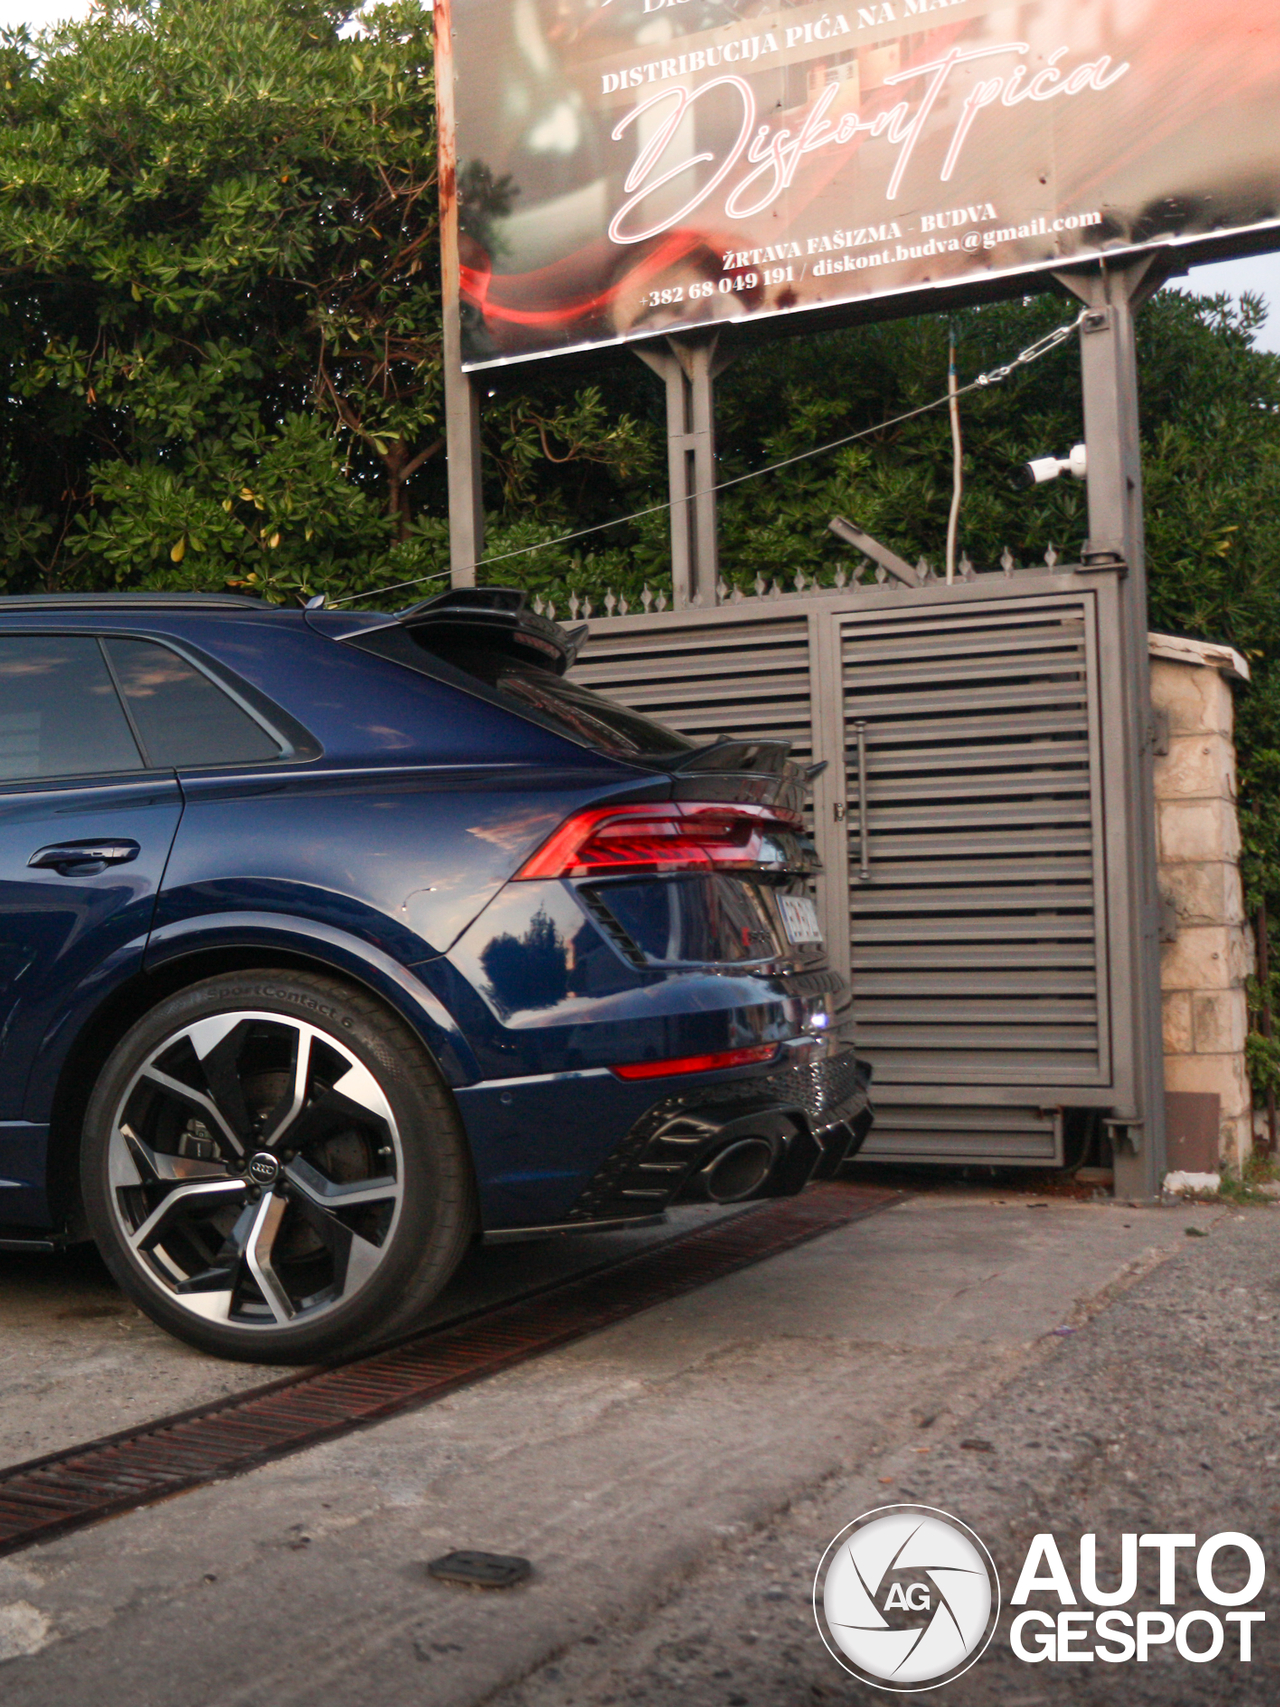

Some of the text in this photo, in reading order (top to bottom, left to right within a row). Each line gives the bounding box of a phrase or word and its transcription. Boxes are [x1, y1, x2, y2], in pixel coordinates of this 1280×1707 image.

[601, 31, 780, 95] DISTRIBUCIJA
[785, 13, 851, 49] PIĆA
[857, 3, 896, 29] NA
[940, 46, 1131, 182] pića
[638, 285, 684, 309] +382
[688, 280, 714, 300] 68
[718, 273, 759, 294] 049
[763, 265, 795, 287] 191
[812, 210, 1103, 278] diskont.budva@gmail.com
[722, 242, 803, 272] ŽRTAVA
[806, 222, 903, 256] FAŠIZMA
[920, 203, 997, 234] BUDVA
[206, 984, 355, 1029] SportContact 6
